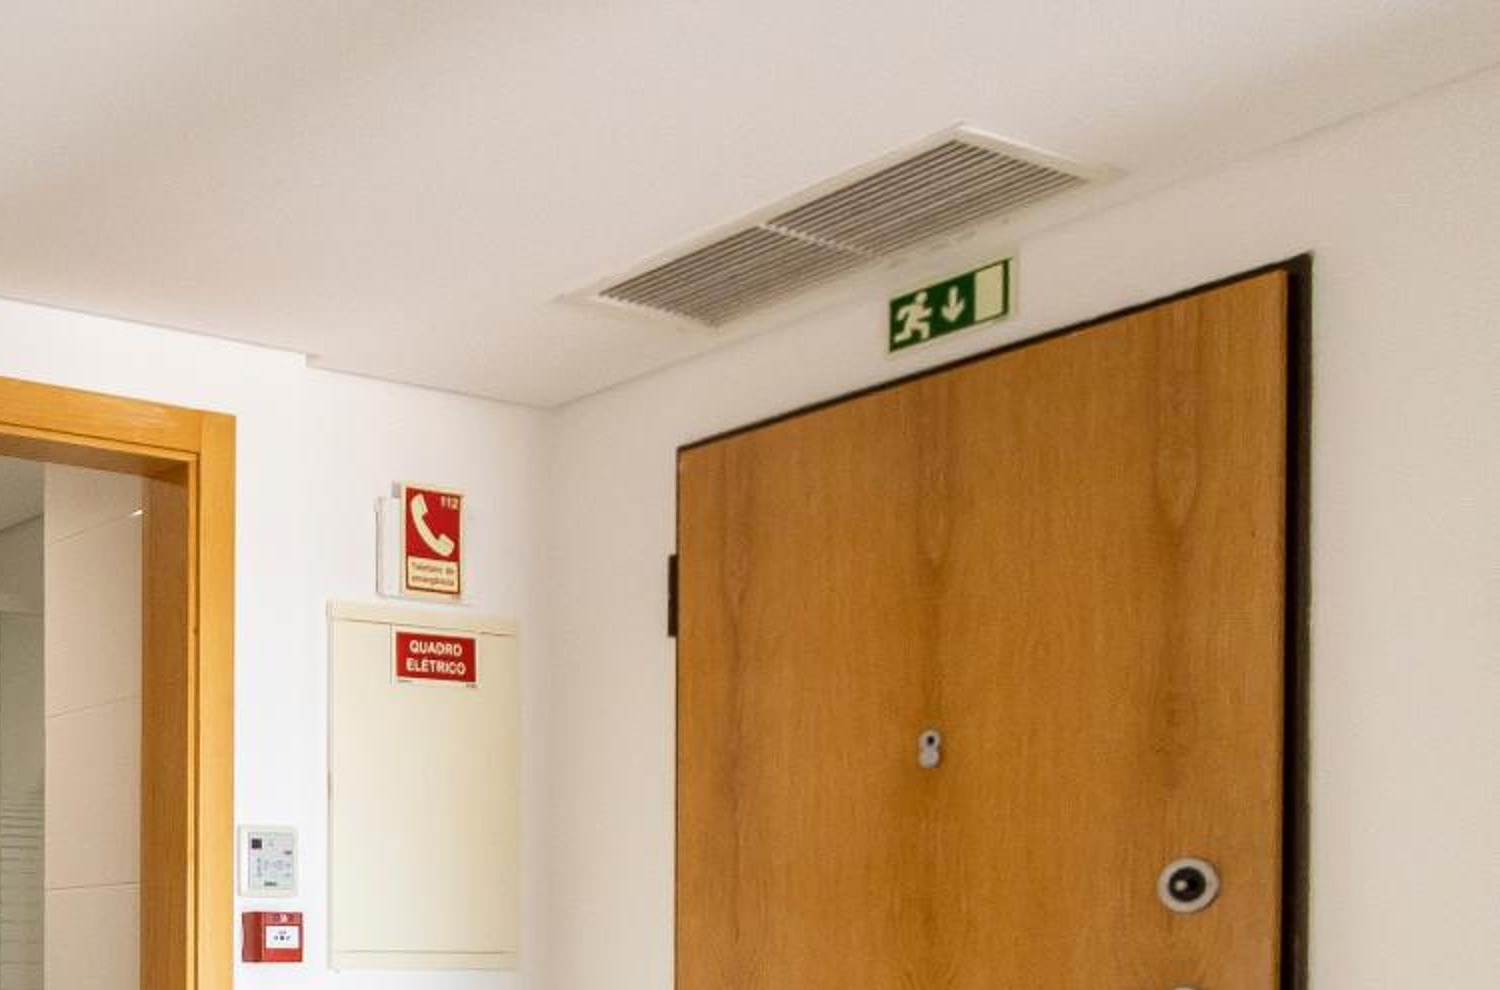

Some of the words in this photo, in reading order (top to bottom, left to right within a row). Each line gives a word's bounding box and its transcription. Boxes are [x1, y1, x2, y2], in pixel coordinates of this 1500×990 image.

[440, 495, 459, 511] 112
[409, 639, 463, 657] QUADRO
[406, 657, 467, 675] ELÉTRICO
